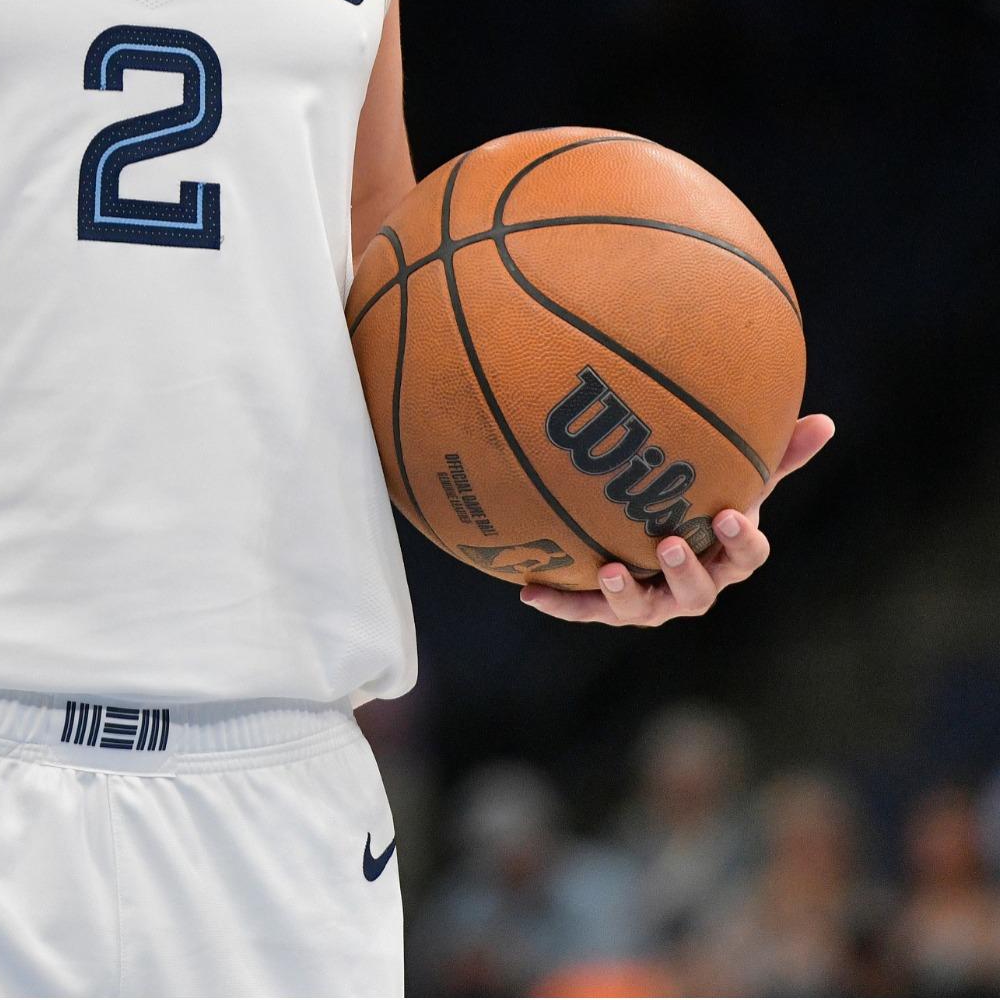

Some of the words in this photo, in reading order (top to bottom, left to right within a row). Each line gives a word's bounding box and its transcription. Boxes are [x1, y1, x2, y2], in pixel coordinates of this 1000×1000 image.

[77, 24, 223, 250] 2
[444, 453, 473, 493] OFFICIAL
[545, 364, 717, 556] Wilso
